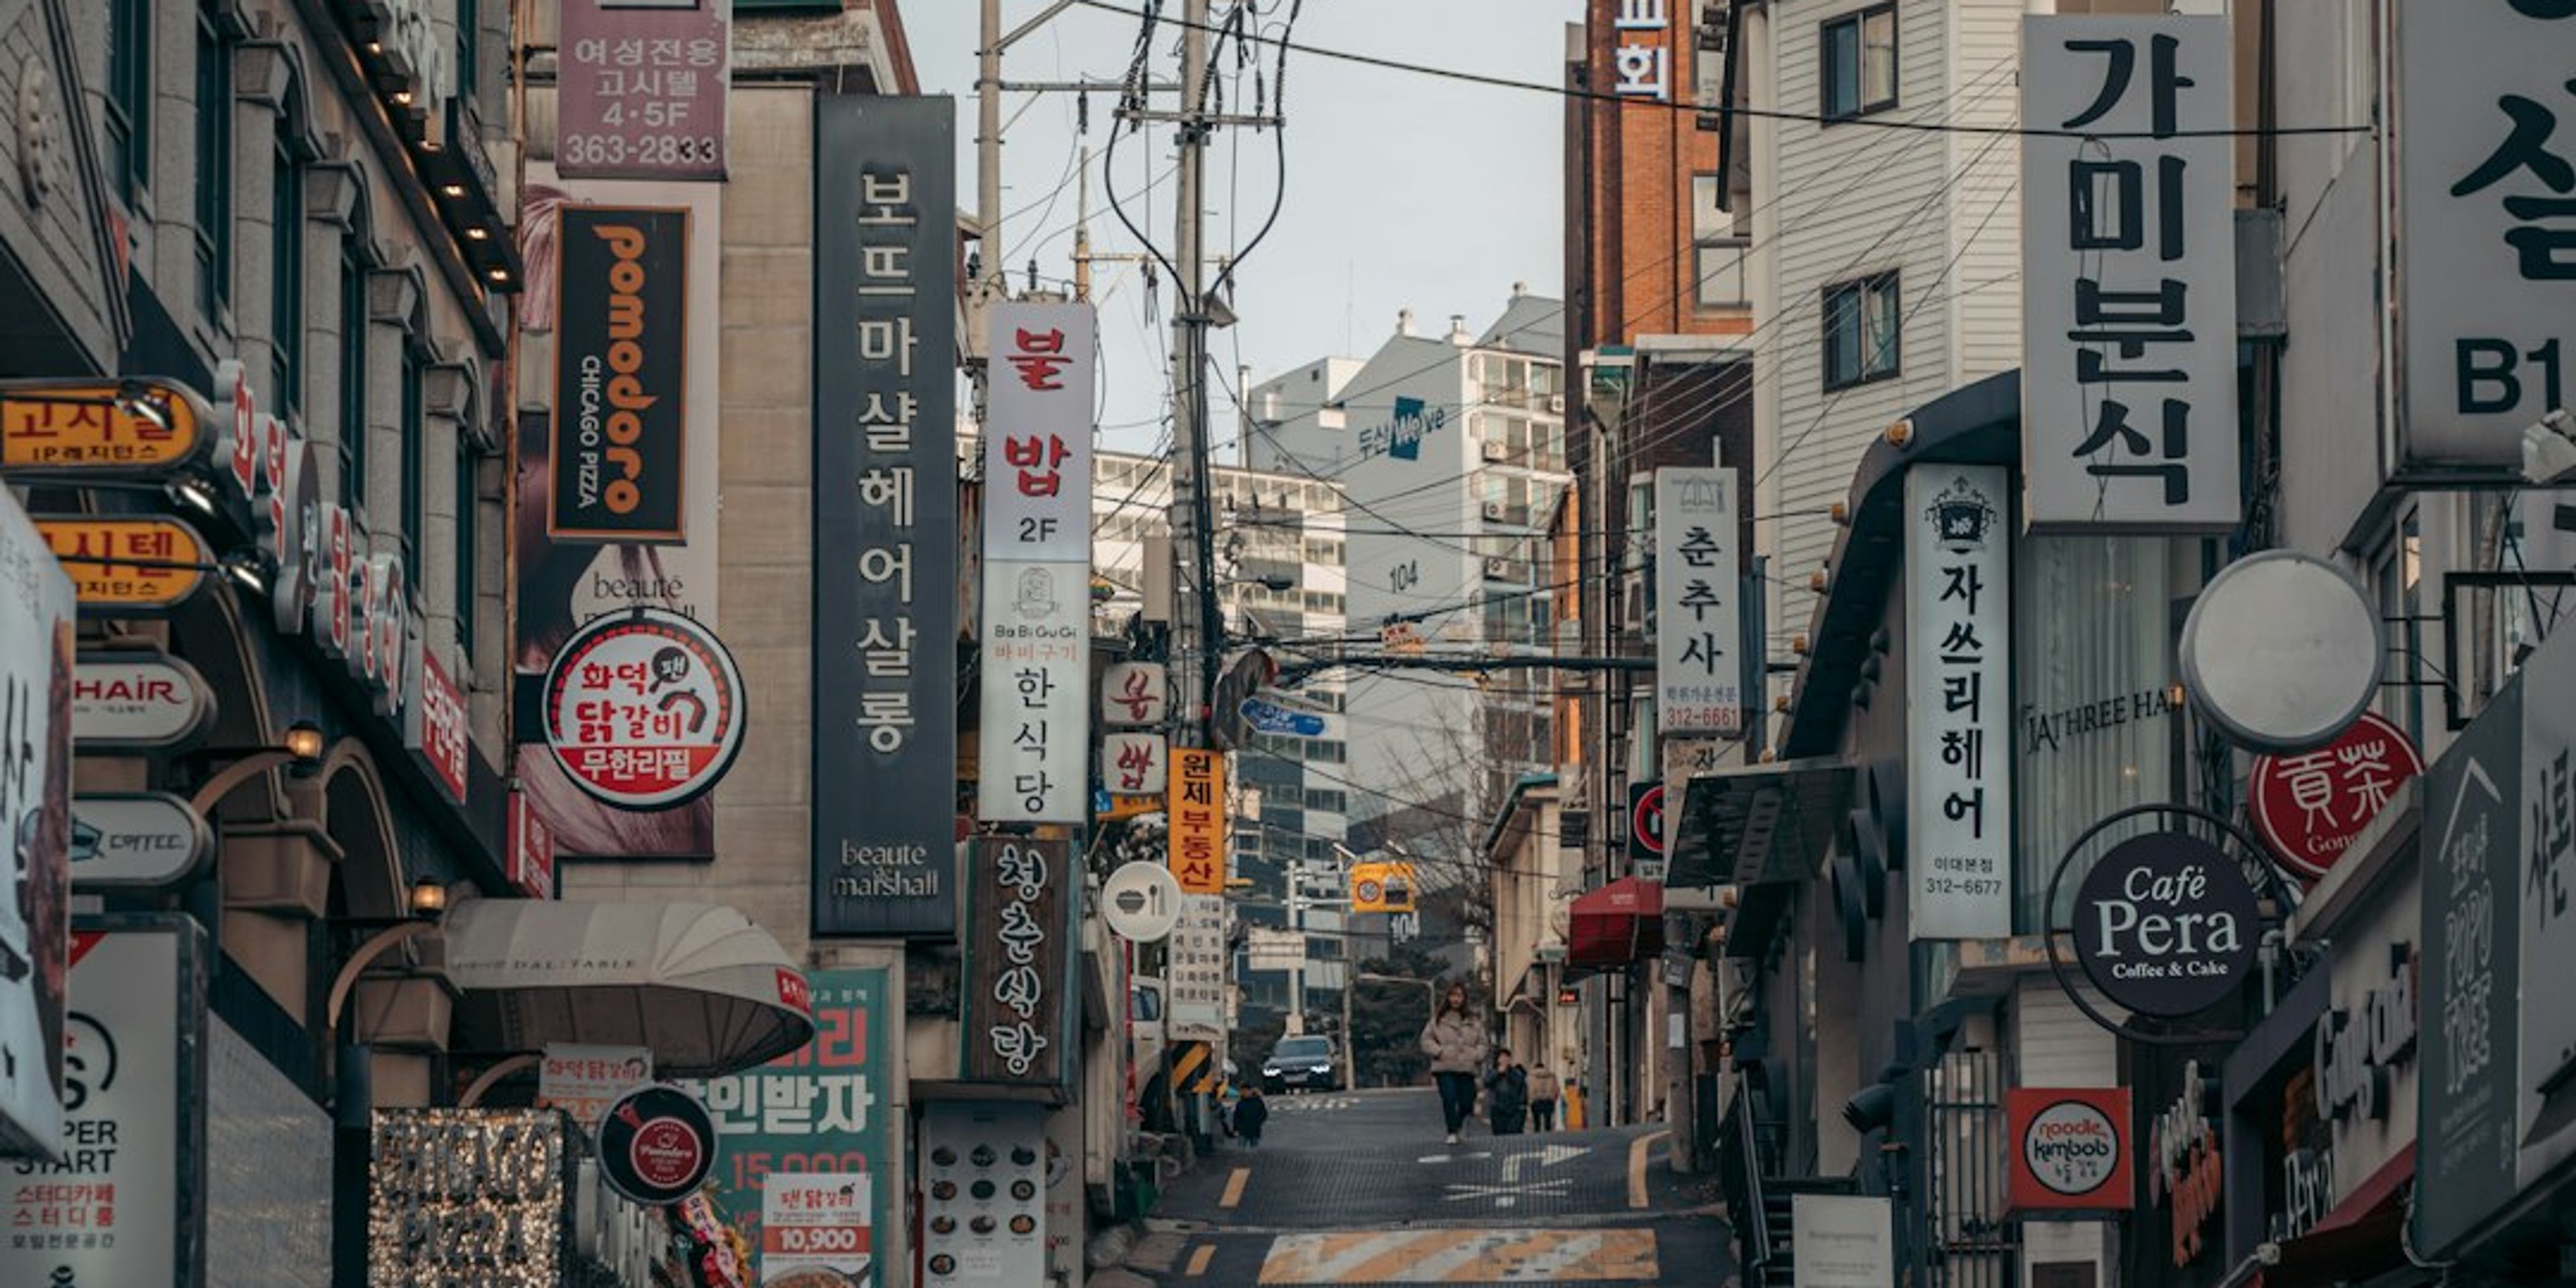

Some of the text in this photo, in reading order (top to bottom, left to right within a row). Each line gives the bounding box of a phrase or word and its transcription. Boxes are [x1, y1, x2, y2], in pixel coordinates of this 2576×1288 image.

[575, 38, 718, 67] 여성전용
[596, 70, 698, 98] 고시텔
[566, 136, 716, 165] 363-2833
[2061, 34, 2196, 507] 가미분식
[592, 225, 659, 515] pomodoro
[578, 356, 600, 508] CHICAGO PIZZA
[857, 173, 918, 753] 보뜨마샬헤어살롱
[1019, 518, 1058, 542] 2F
[1390, 559, 1418, 594] 104
[1678, 527, 1723, 675] 춘추사
[582, 661, 648, 696] 화덕
[1668, 706, 1737, 727] 312-6661
[1940, 565, 1984, 839] 자쓰리헤어
[575, 700, 686, 744] 닭갈비
[1013, 667, 1057, 815] 한식당
[580, 747, 691, 782] 무한리필
[1927, 877, 2002, 896] 312-6677
[2125, 865, 2206, 906] Café
[1391, 911, 1421, 945] 104
[2092, 900, 2242, 958] Pera
[991, 843, 1047, 1075] 청춘식당
[2113, 961, 2229, 979] Coffee & Cake
[13, 1184, 115, 1204] 스터디카페
[13, 1207, 115, 1228] 스터디룸
[780, 1228, 857, 1253] 10,900
